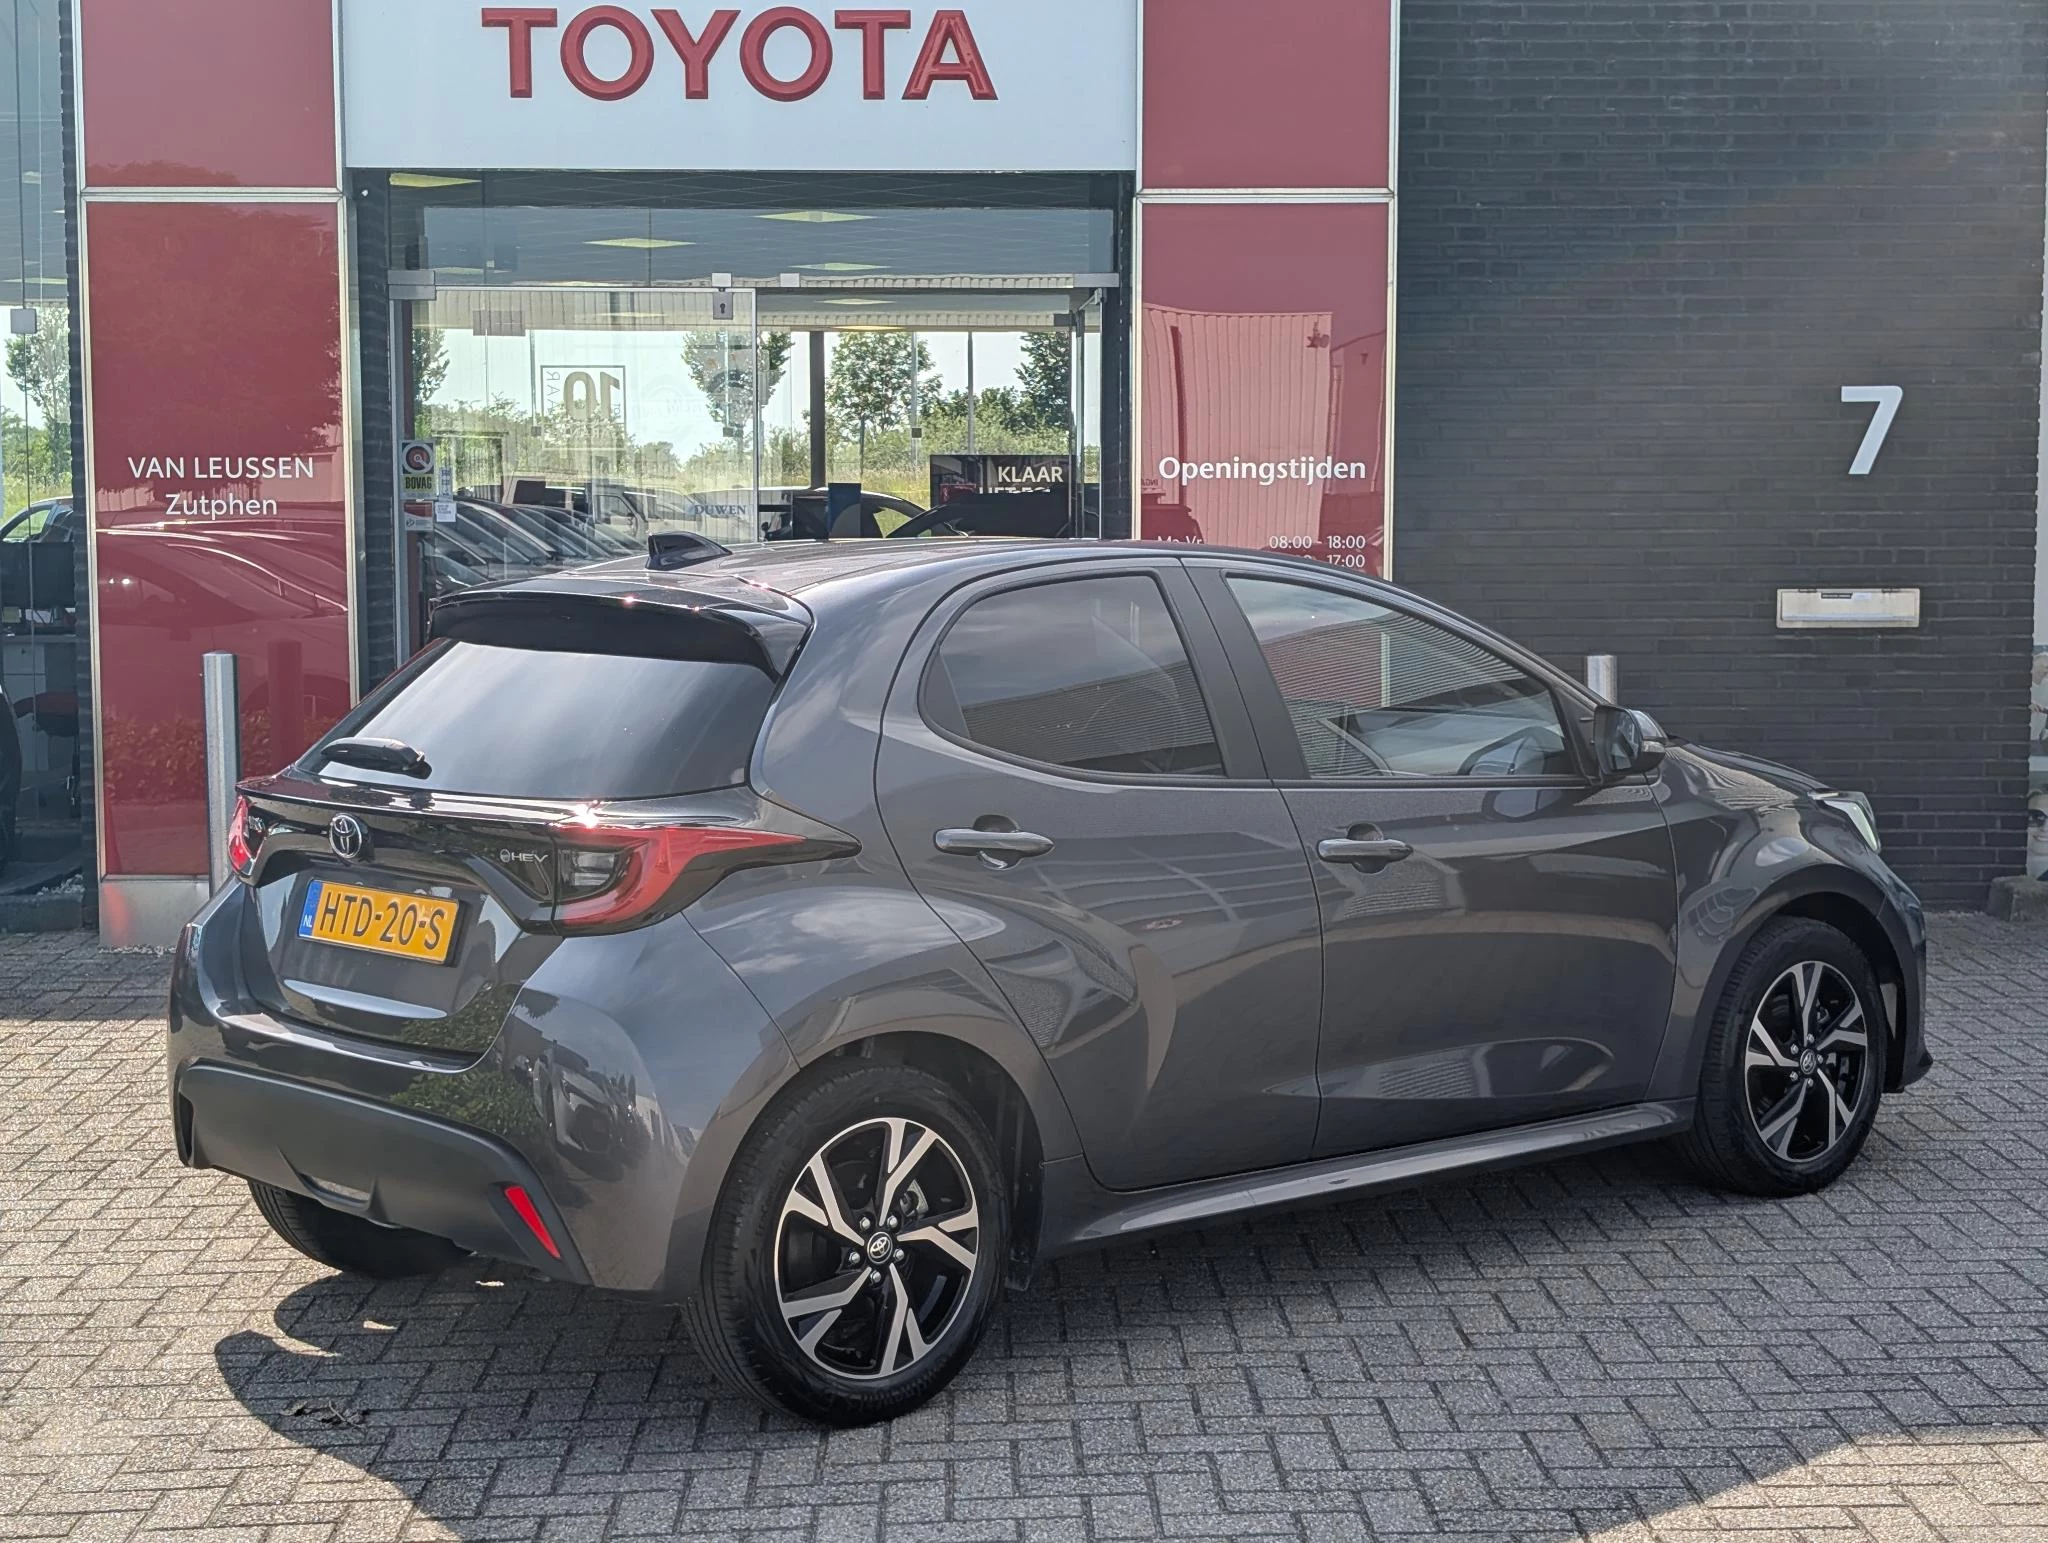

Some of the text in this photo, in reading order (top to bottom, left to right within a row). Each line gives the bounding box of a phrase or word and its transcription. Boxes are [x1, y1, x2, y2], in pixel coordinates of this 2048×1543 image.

[482, 5, 998, 102] TOYOTA
[1840, 385, 1903, 475] 7
[128, 457, 314, 478] VAN LEUSSEN
[998, 466, 1064, 483] KLAAR
[1159, 456, 1366, 486] Openingstijden
[405, 476, 432, 490] BOVAG
[165, 493, 278, 521] Zutphen
[694, 504, 746, 515] DUWEN
[1269, 535, 1312, 549] 08:00
[1326, 535, 1366, 549] 18:00
[1326, 554, 1366, 568] 17:00
[511, 852, 549, 863] HEV
[303, 914, 313, 928] NL
[320, 891, 445, 950] HTD-20-S
